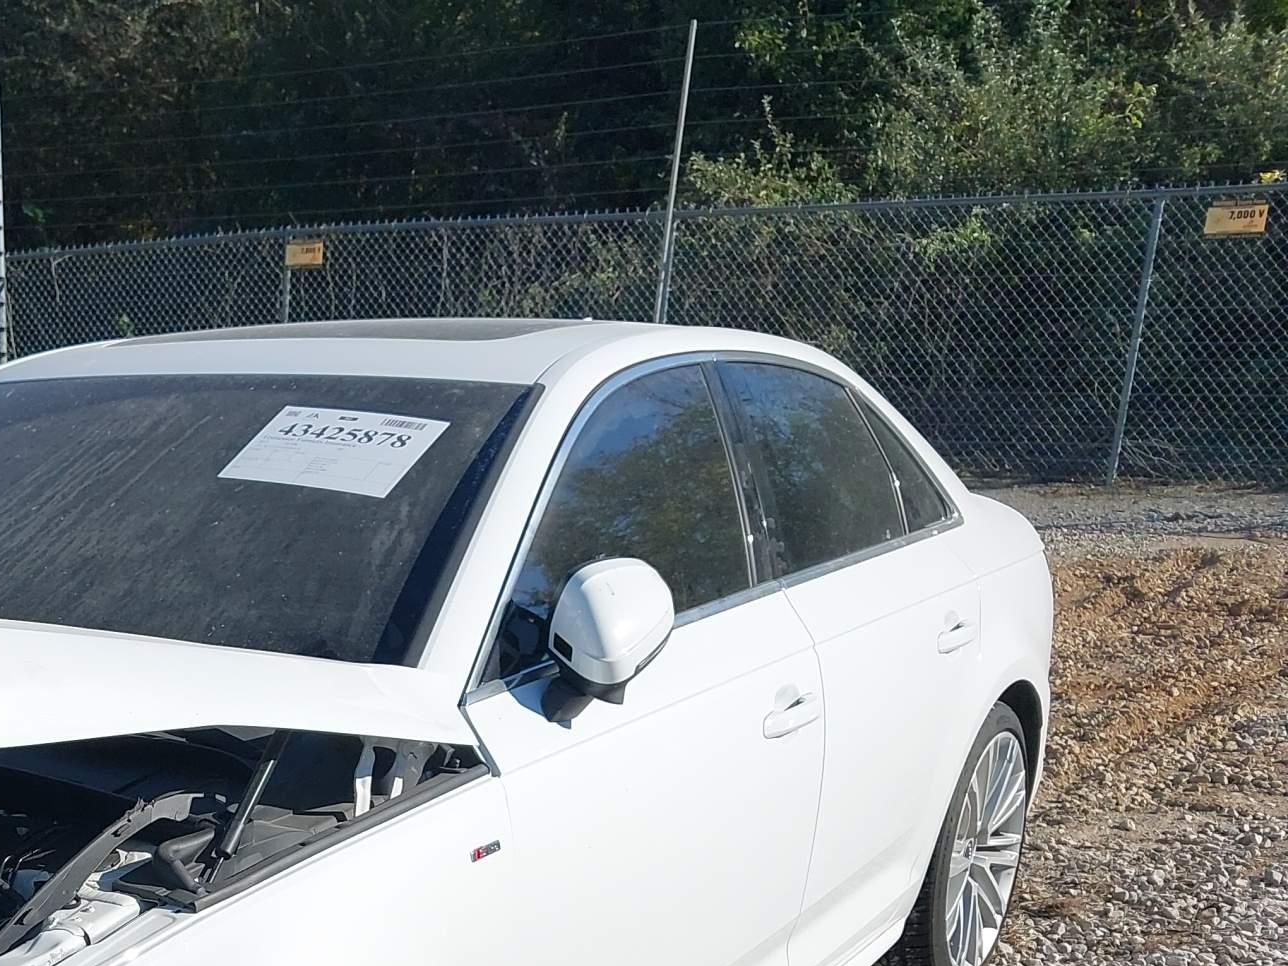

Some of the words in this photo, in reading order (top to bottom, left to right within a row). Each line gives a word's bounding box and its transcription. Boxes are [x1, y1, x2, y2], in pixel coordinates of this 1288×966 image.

[1228, 209, 1256, 221] 7,000
[1259, 208, 1266, 218] V
[278, 422, 413, 449] 43425878
